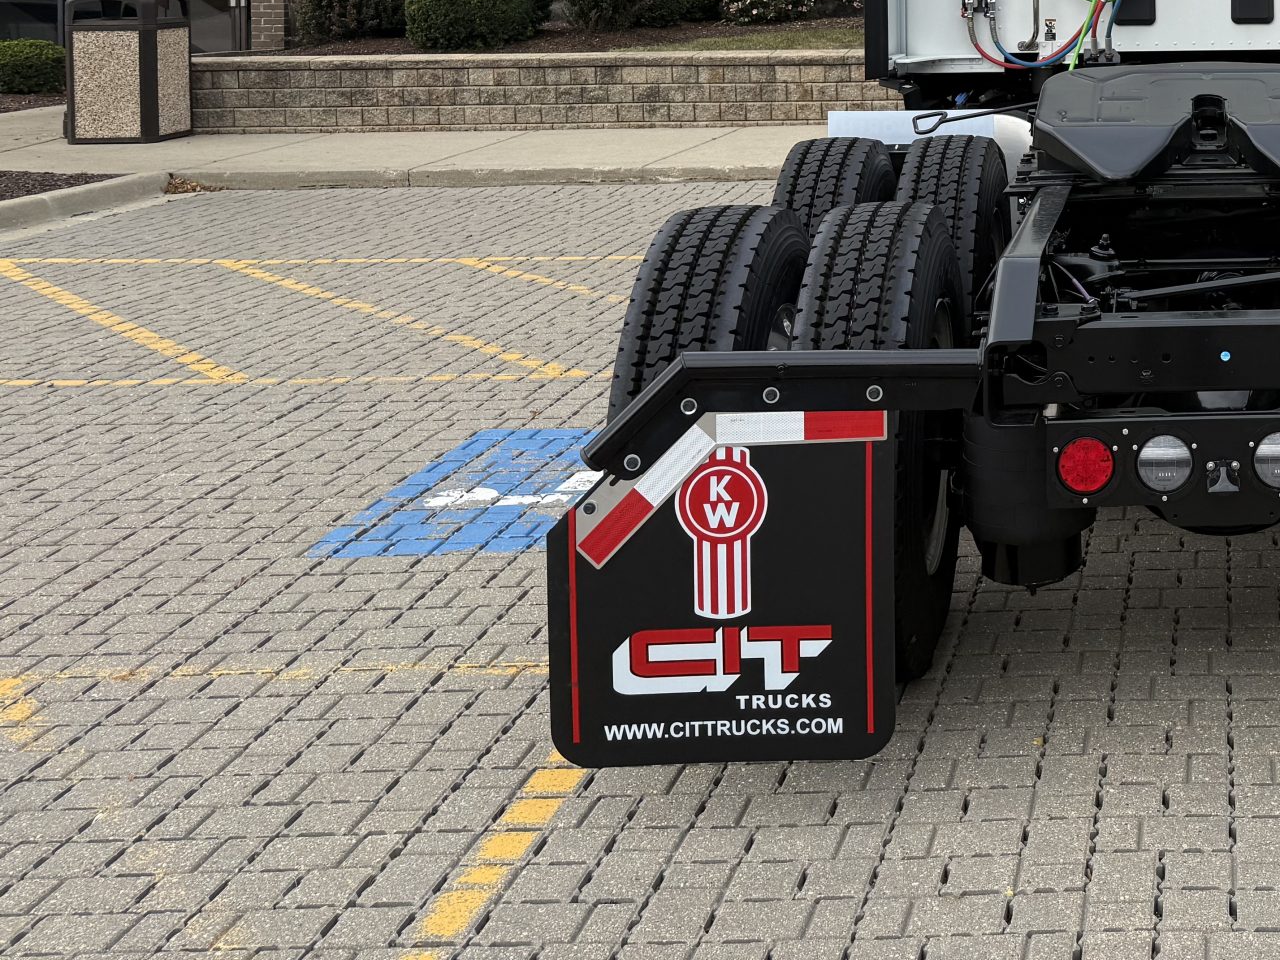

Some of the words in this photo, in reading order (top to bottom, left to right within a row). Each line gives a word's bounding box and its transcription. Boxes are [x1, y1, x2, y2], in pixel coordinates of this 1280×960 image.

[612, 625, 832, 695] CIT
[736, 693, 832, 709] TRUCKS
[604, 717, 844, 741] WWW.CITTRUCKS.COM
